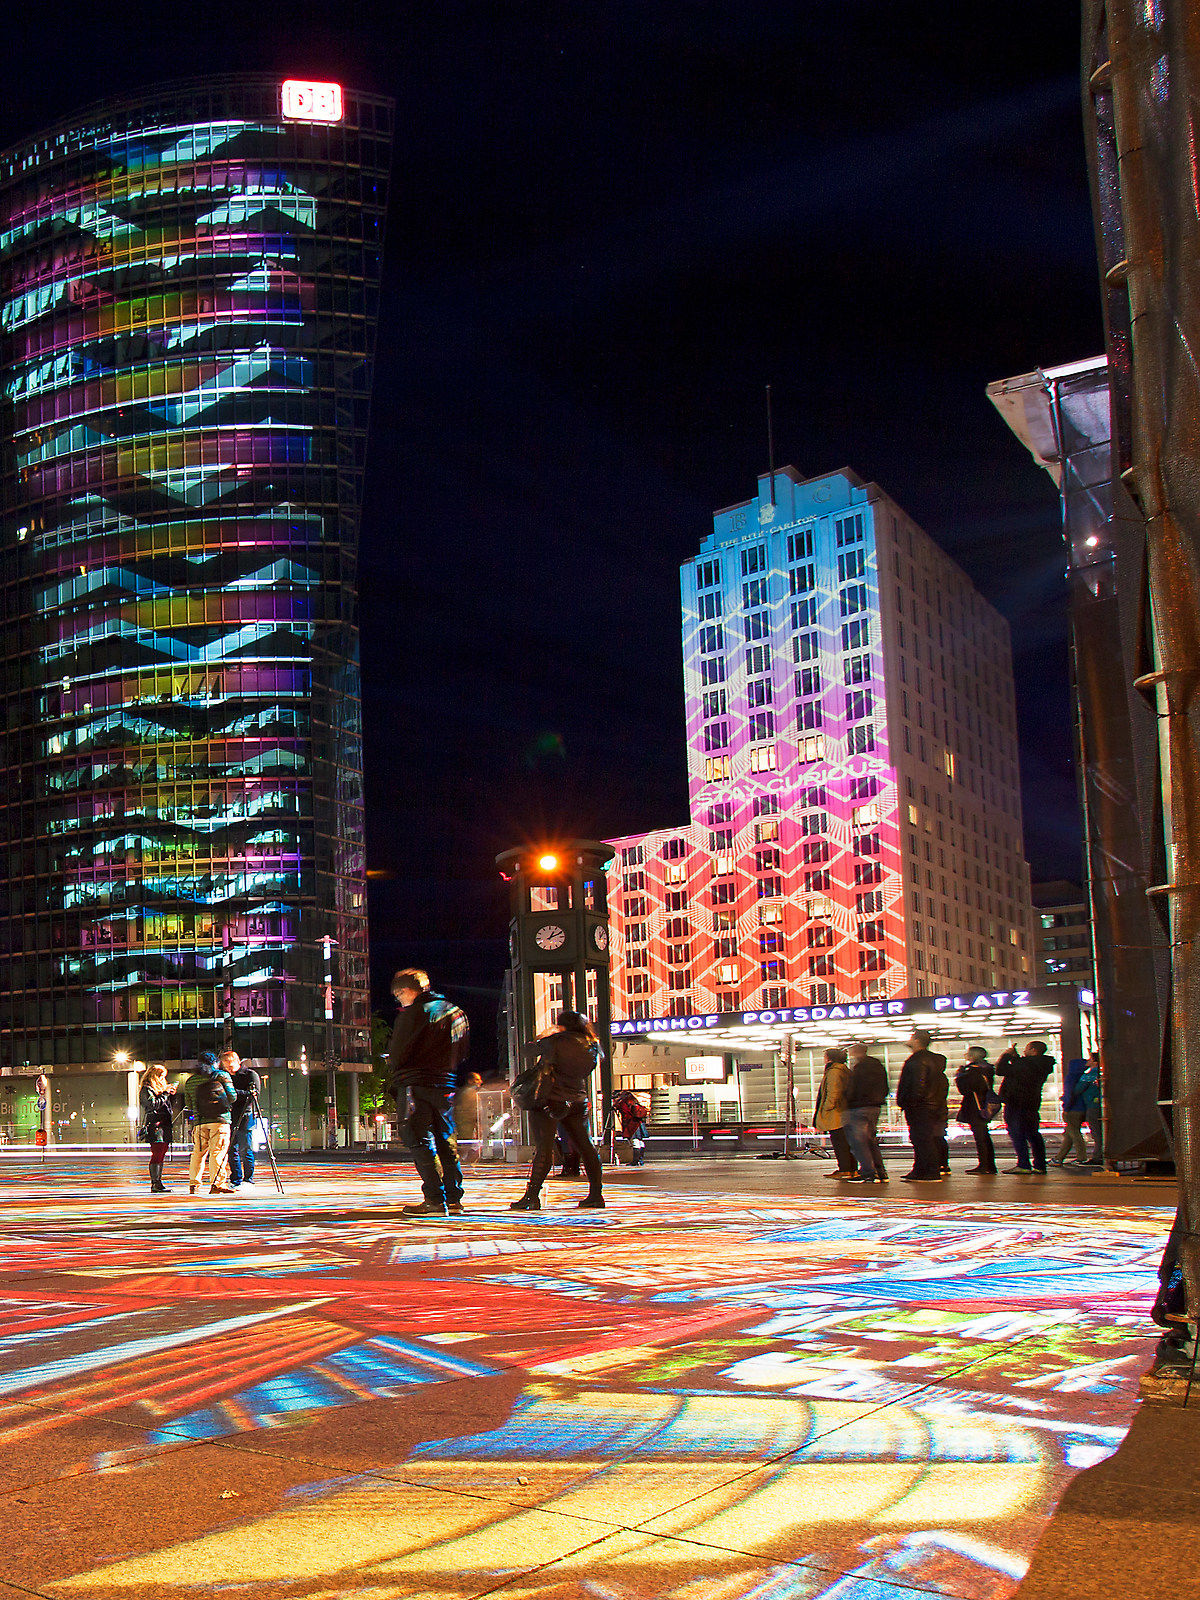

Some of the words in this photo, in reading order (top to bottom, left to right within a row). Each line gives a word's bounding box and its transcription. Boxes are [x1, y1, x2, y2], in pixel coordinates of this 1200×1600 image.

[611, 1015, 719, 1034] BAHNHOF
[742, 1002, 904, 1025] POTSDAMER
[934, 991, 1030, 1011] PLATZ
[690, 1064, 705, 1073] DB
